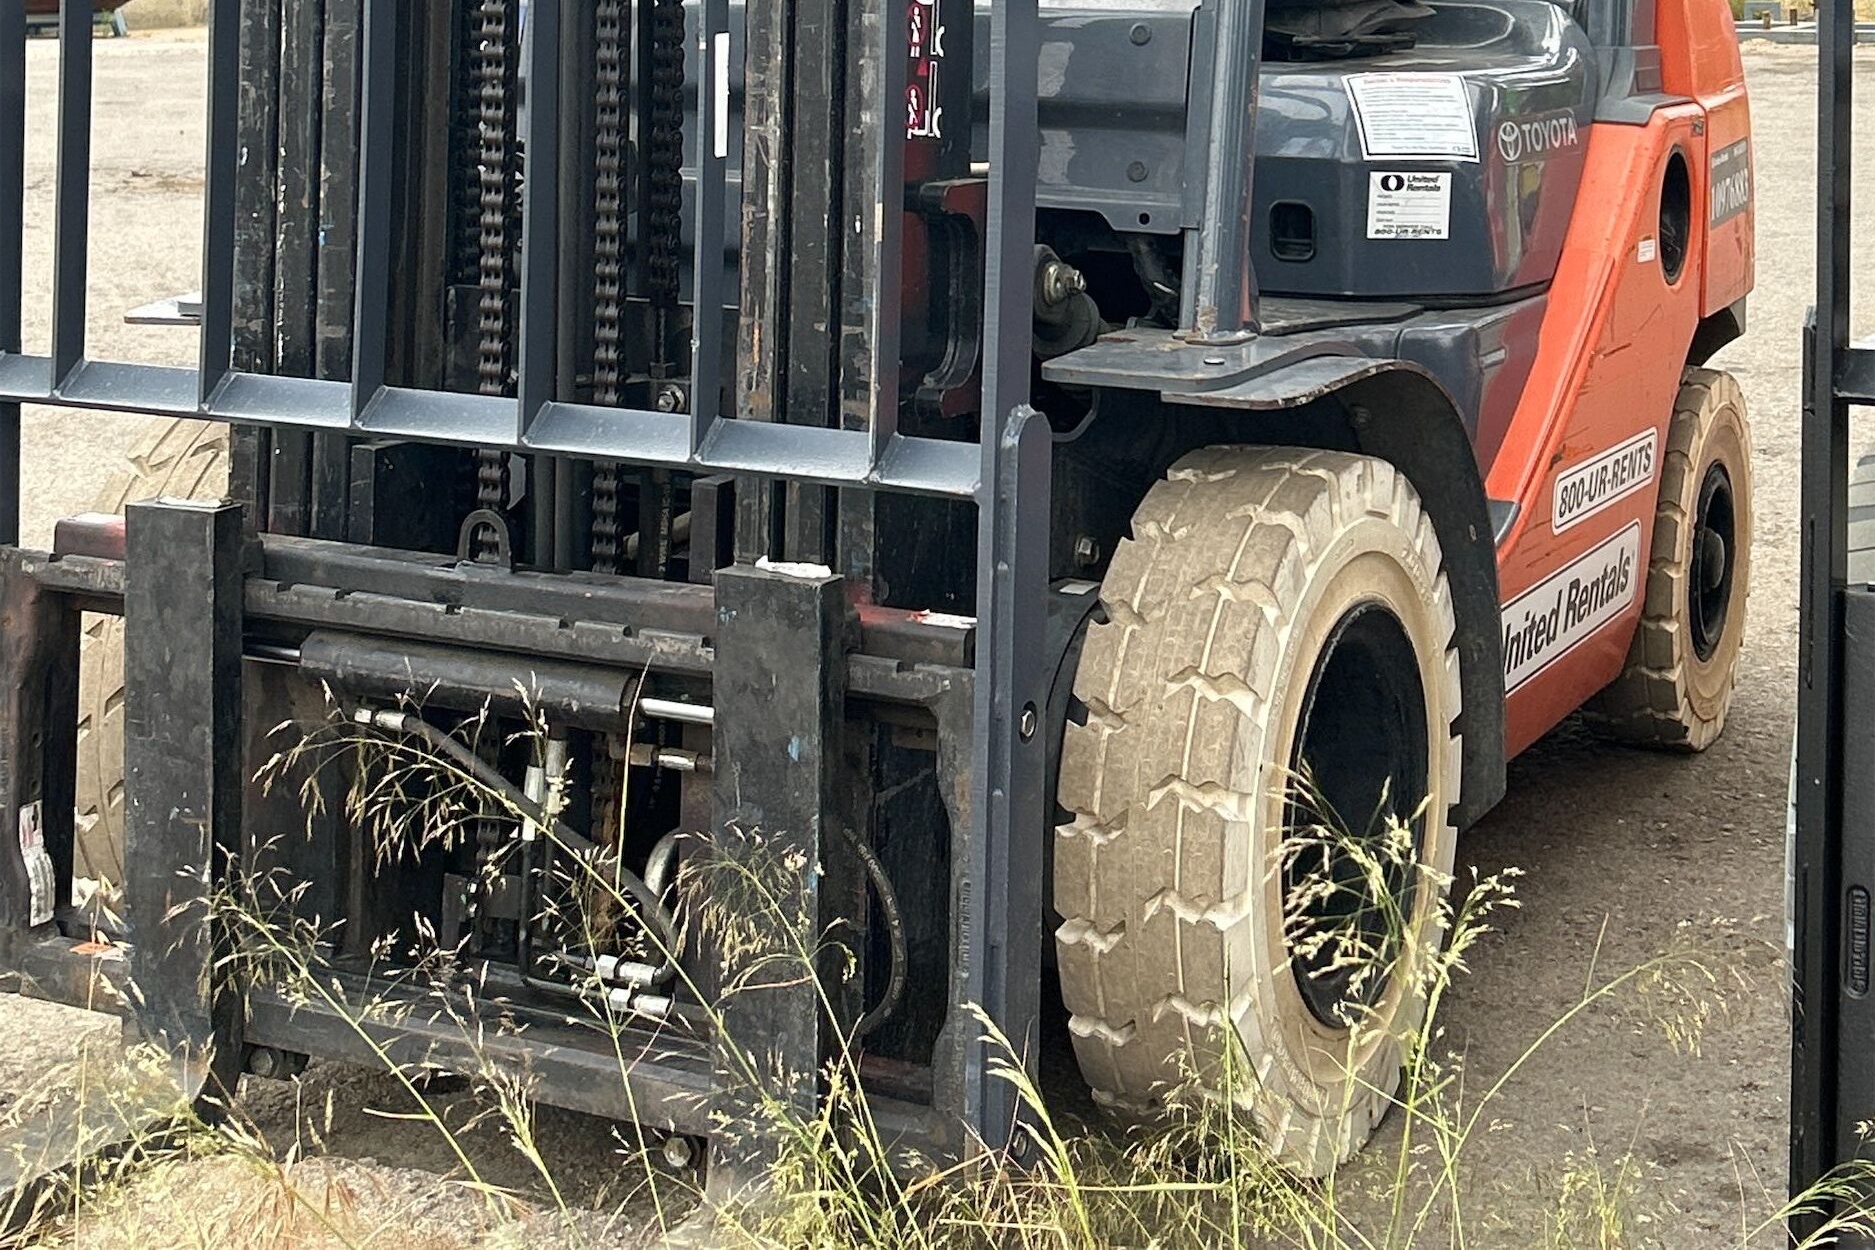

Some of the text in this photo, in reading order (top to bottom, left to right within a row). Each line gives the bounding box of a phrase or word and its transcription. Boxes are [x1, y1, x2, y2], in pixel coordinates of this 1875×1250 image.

[1521, 117, 1578, 153] TOYOTA
[1406, 183, 1441, 192] Rentals
[1407, 174, 1440, 183] United
[1558, 441, 1653, 519] 800-UR-RENTS
[1563, 546, 1631, 634] Rentals
